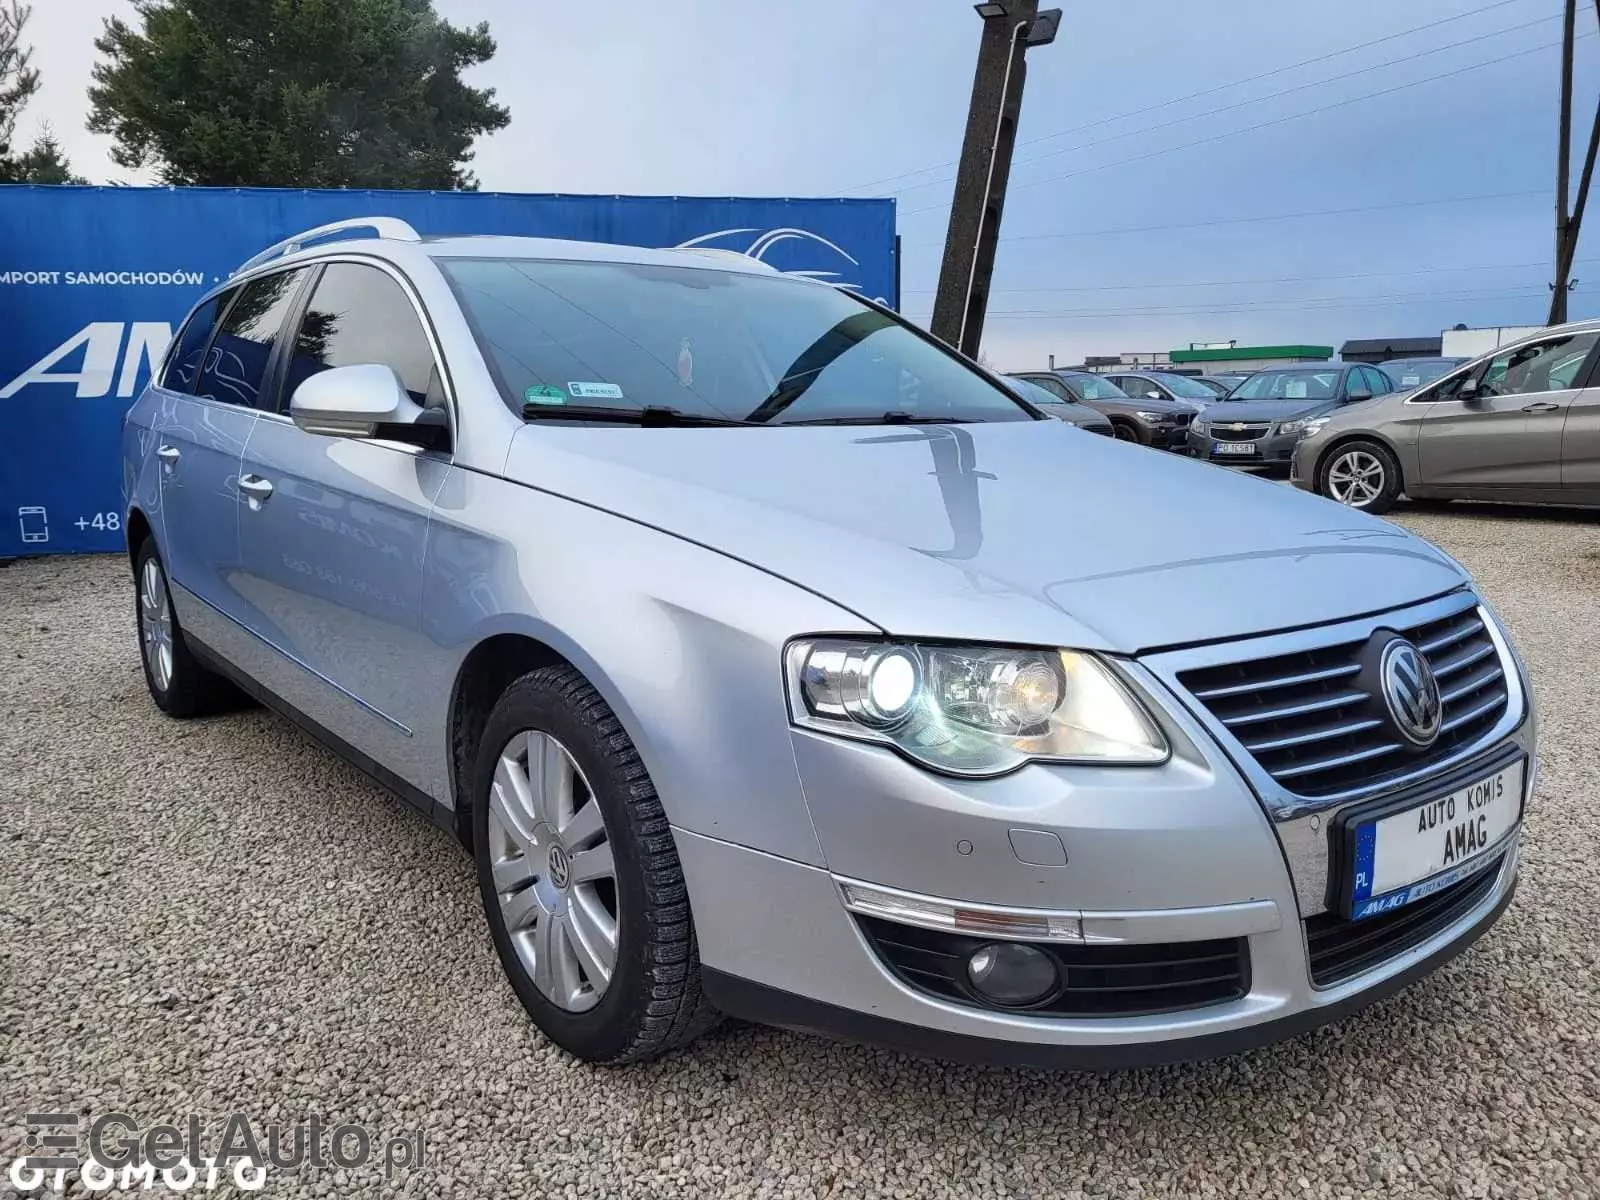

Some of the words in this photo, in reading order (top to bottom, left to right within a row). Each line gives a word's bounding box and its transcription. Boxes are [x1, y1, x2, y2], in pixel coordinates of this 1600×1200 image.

[65, 268, 204, 284] SAMOCHODÓW
[74, 513, 121, 531] +48
[1418, 798, 1455, 833] AUTO
[1467, 775, 1504, 811] KOMIS
[1443, 814, 1488, 865] AMAG
[1355, 872, 1369, 890] PL
